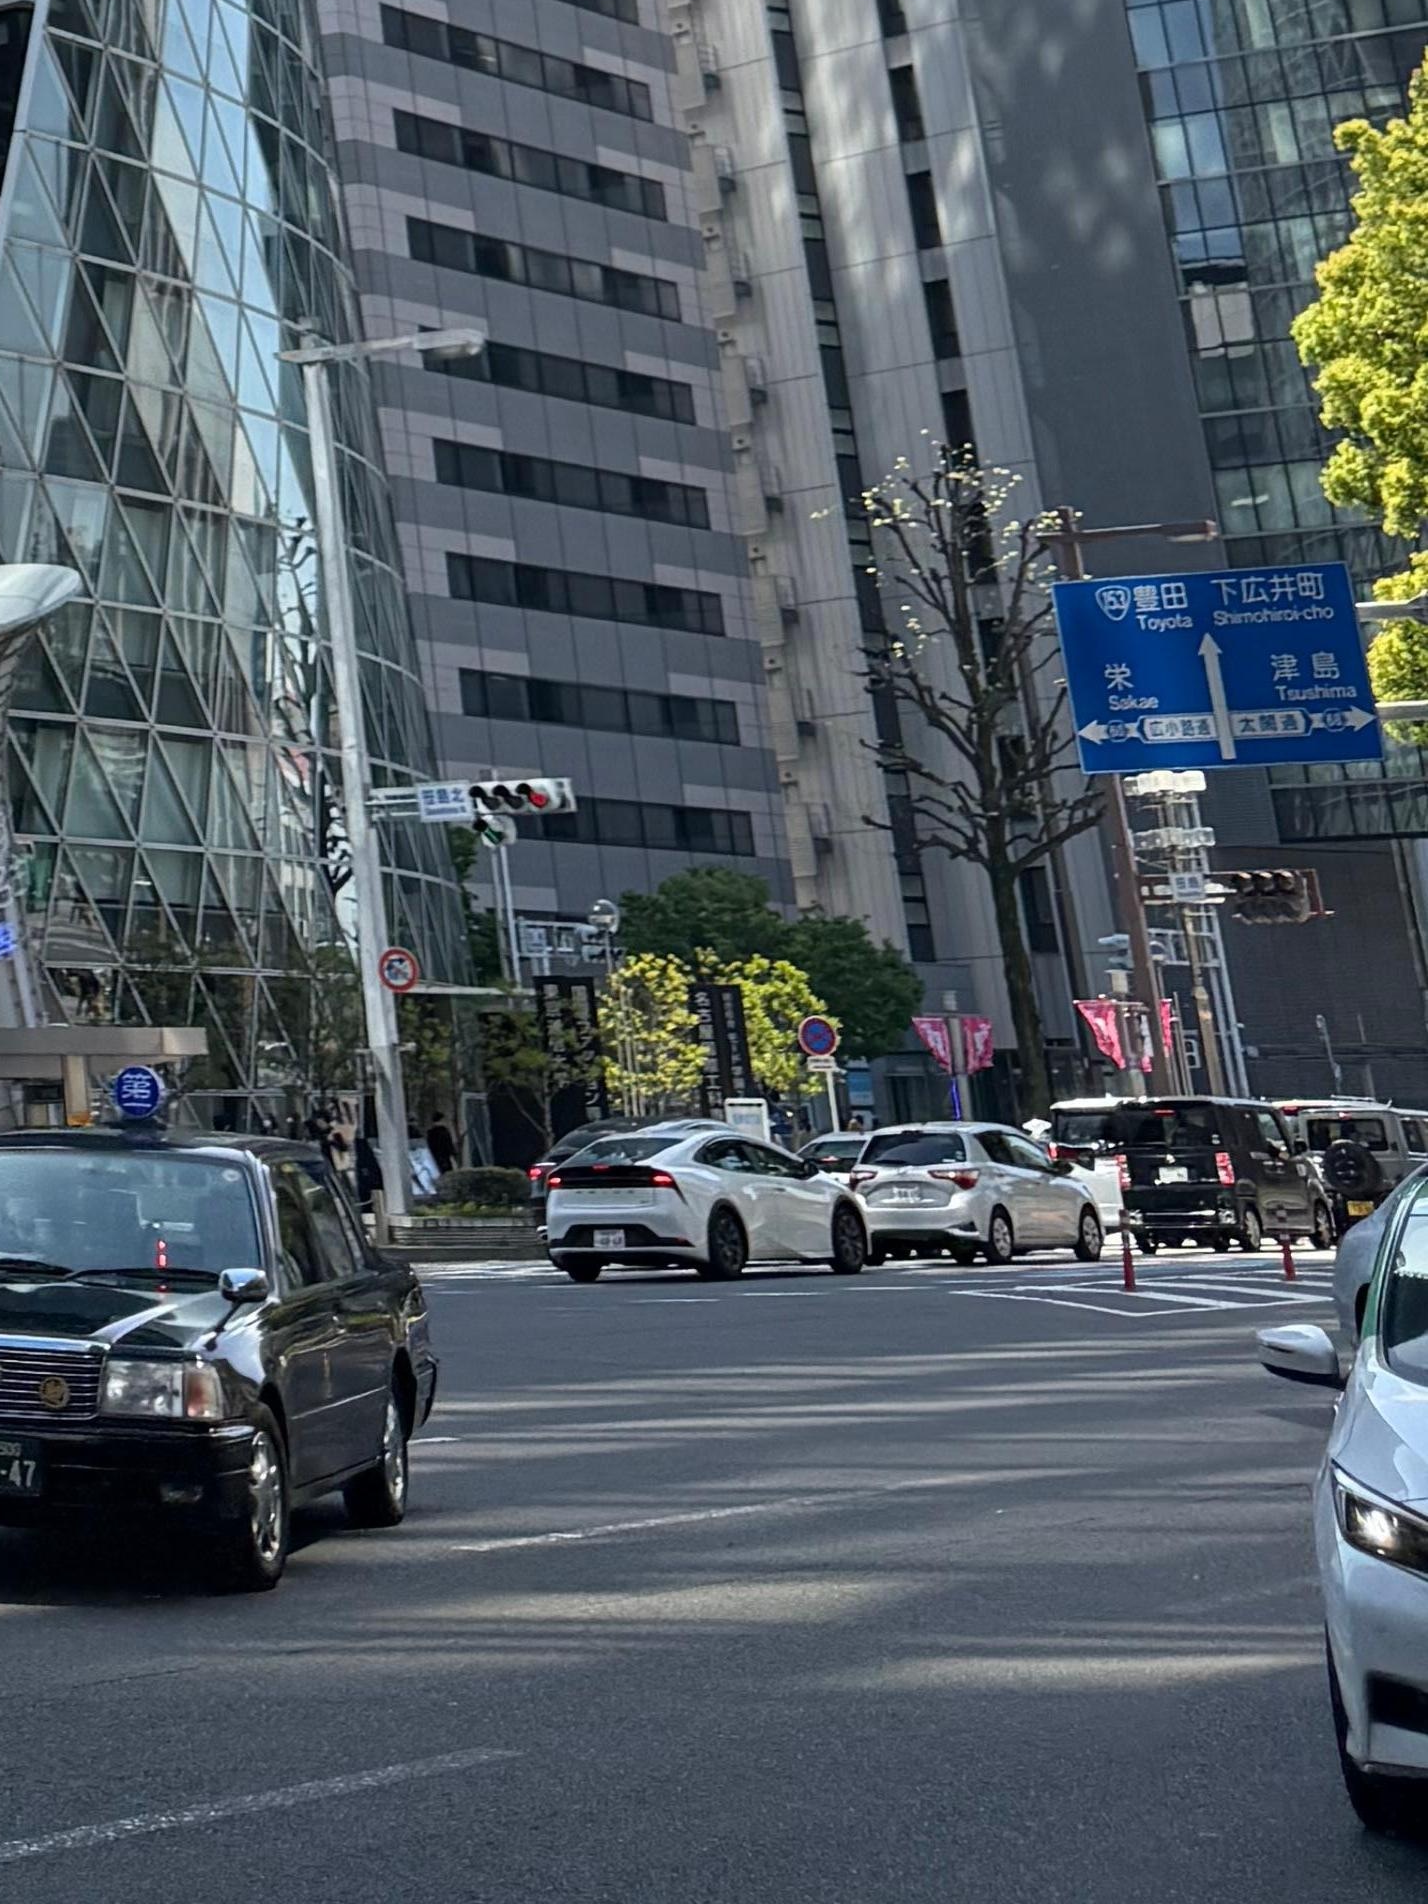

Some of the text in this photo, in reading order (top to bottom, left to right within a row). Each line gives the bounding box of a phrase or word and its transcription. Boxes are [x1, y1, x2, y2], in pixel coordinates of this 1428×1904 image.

[1102, 590, 1126, 610] 153
[1133, 582, 1188, 612] 豊田
[1210, 572, 1324, 605] 下広井町
[1136, 613, 1194, 632] Toyota
[1213, 604, 1334, 626] Shimohiroi-cho
[1104, 663, 1134, 690] 栄
[1270, 650, 1340, 681] 津島
[1275, 684, 1357, 701] Tsushima
[122, 1073, 152, 1108] 第一
